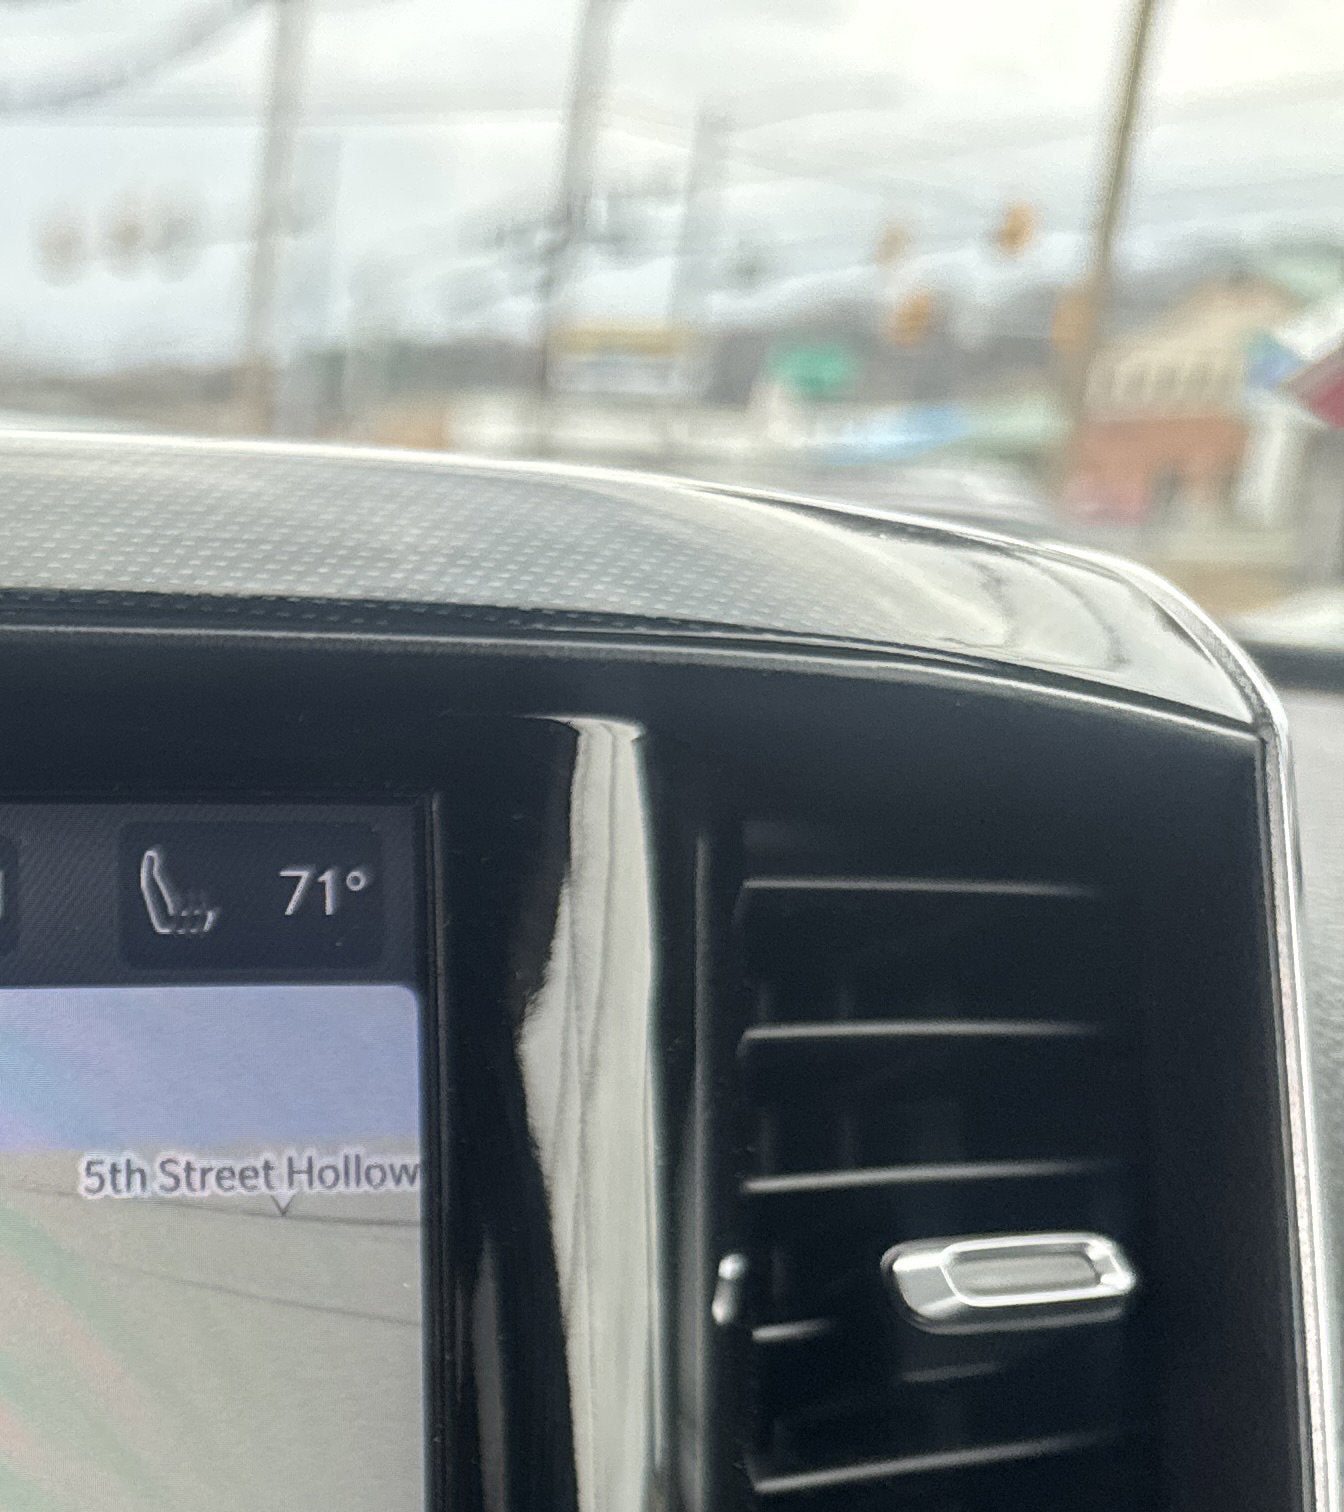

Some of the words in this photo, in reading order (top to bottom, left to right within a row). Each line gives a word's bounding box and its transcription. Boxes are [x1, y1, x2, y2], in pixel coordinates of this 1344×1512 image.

[278, 869, 368, 915] 71°
[83, 1158, 146, 1195] 5th
[159, 1155, 275, 1193] Street
[287, 1153, 420, 1190] Hollow
